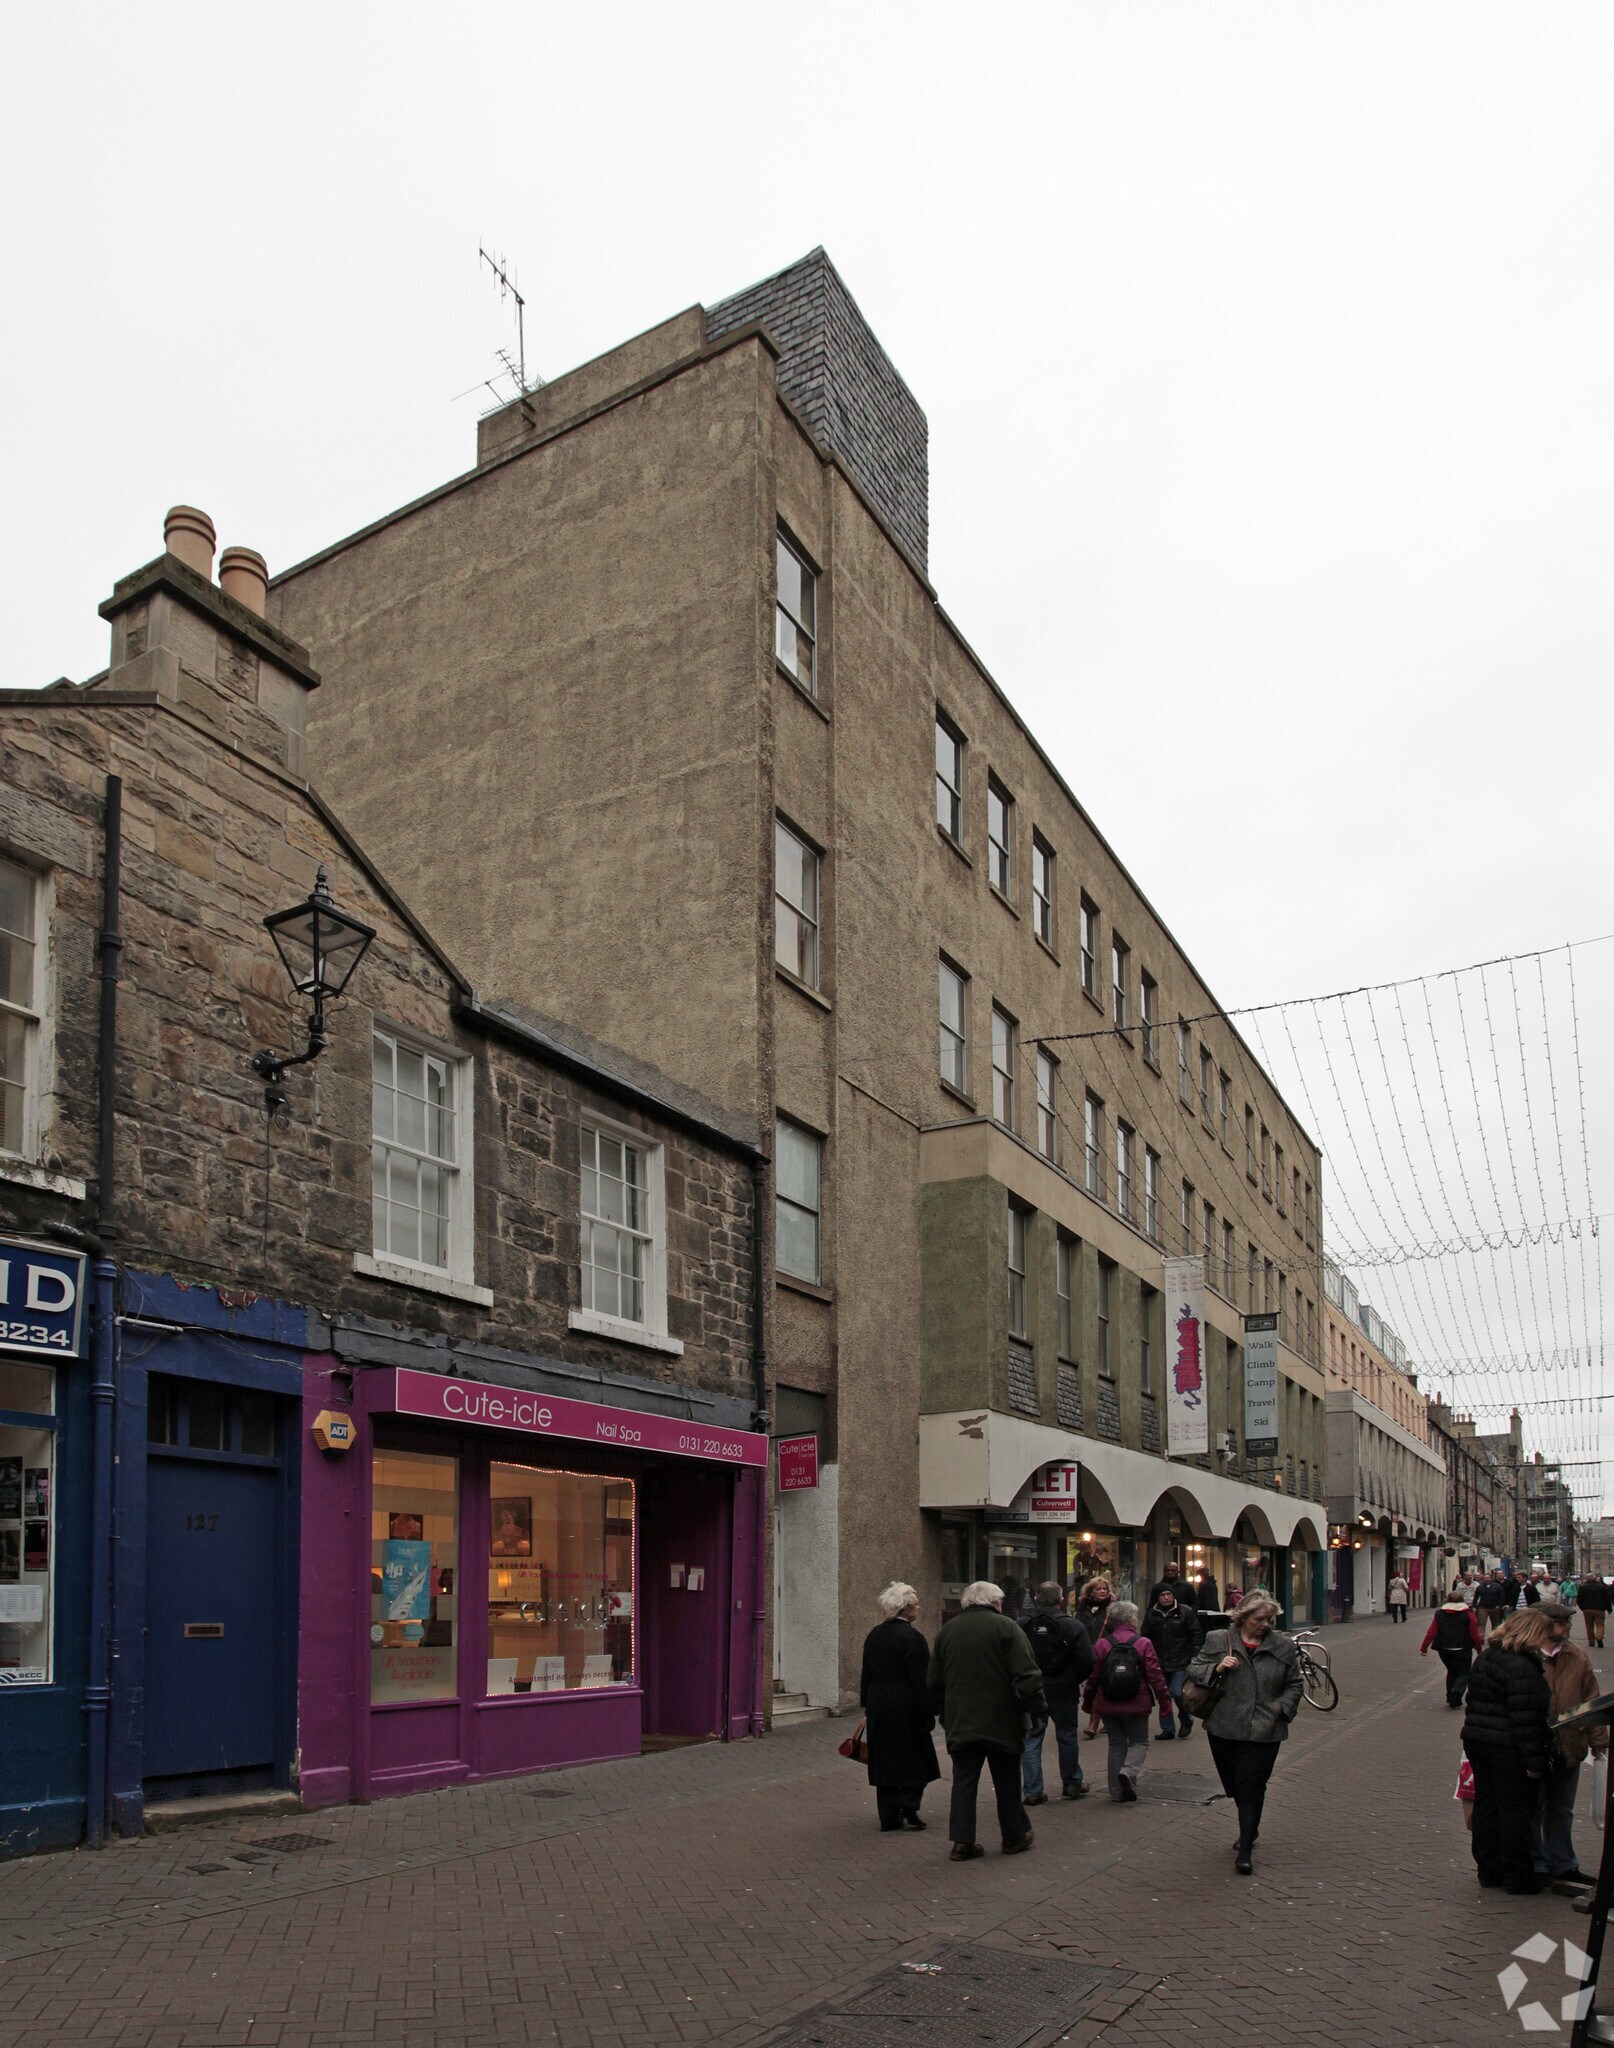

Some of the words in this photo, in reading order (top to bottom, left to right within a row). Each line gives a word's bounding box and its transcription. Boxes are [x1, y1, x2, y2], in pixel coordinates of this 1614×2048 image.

[1248, 1341, 1273, 1350] Walk
[1247, 1360, 1275, 1369] Climb
[1247, 1379, 1275, 1388] Camp
[1247, 1398, 1275, 1407] Travel
[443, 1385, 552, 1427] Cute-icle
[596, 1422, 617, 1438] Nail
[620, 1425, 641, 1442] Spa
[679, 1435, 700, 1451] 0131
[704, 1439, 720, 1454] 220
[722, 1443, 743, 1458] 6633
[1254, 1418, 1269, 1426] Ski
[331, 1426, 348, 1437] ADT
[781, 1445, 799, 1454] Cute
[791, 1467, 805, 1475] 0131
[785, 1478, 796, 1486] 220
[797, 1476, 812, 1485] 6633
[1032, 1468, 1075, 1492] LET
[186, 1512, 221, 1532] 127
[520, 1599, 568, 1622] cute
